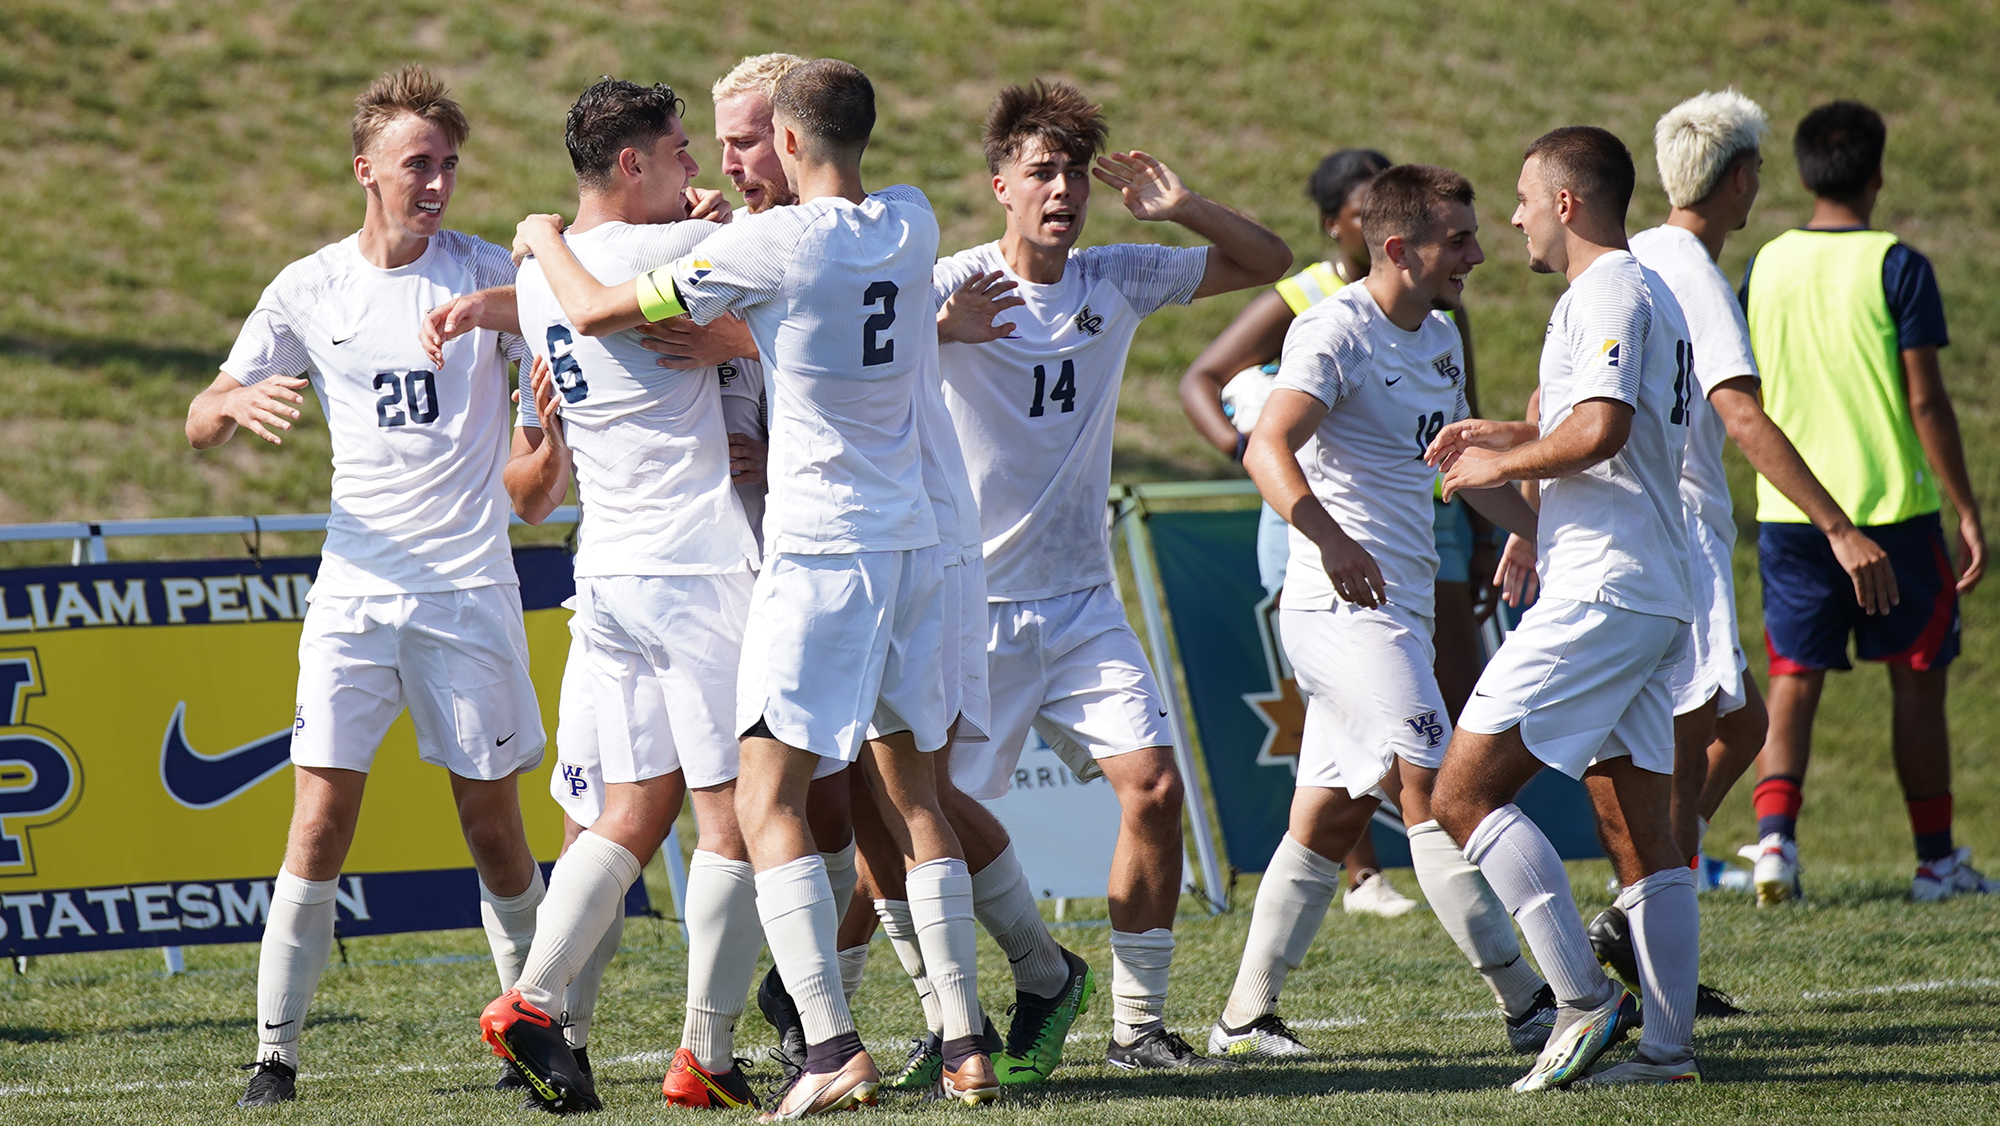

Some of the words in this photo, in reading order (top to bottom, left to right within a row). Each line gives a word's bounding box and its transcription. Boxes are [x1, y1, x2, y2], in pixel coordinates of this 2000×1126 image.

[862, 280, 899, 367] 2
[546, 323, 589, 404] 6
[1029, 358, 1077, 418] 14
[372, 369, 440, 428] 20
[1403, 710, 1444, 749] WP
[560, 760, 589, 799] WP
[0, 876, 372, 941] TATESMN
